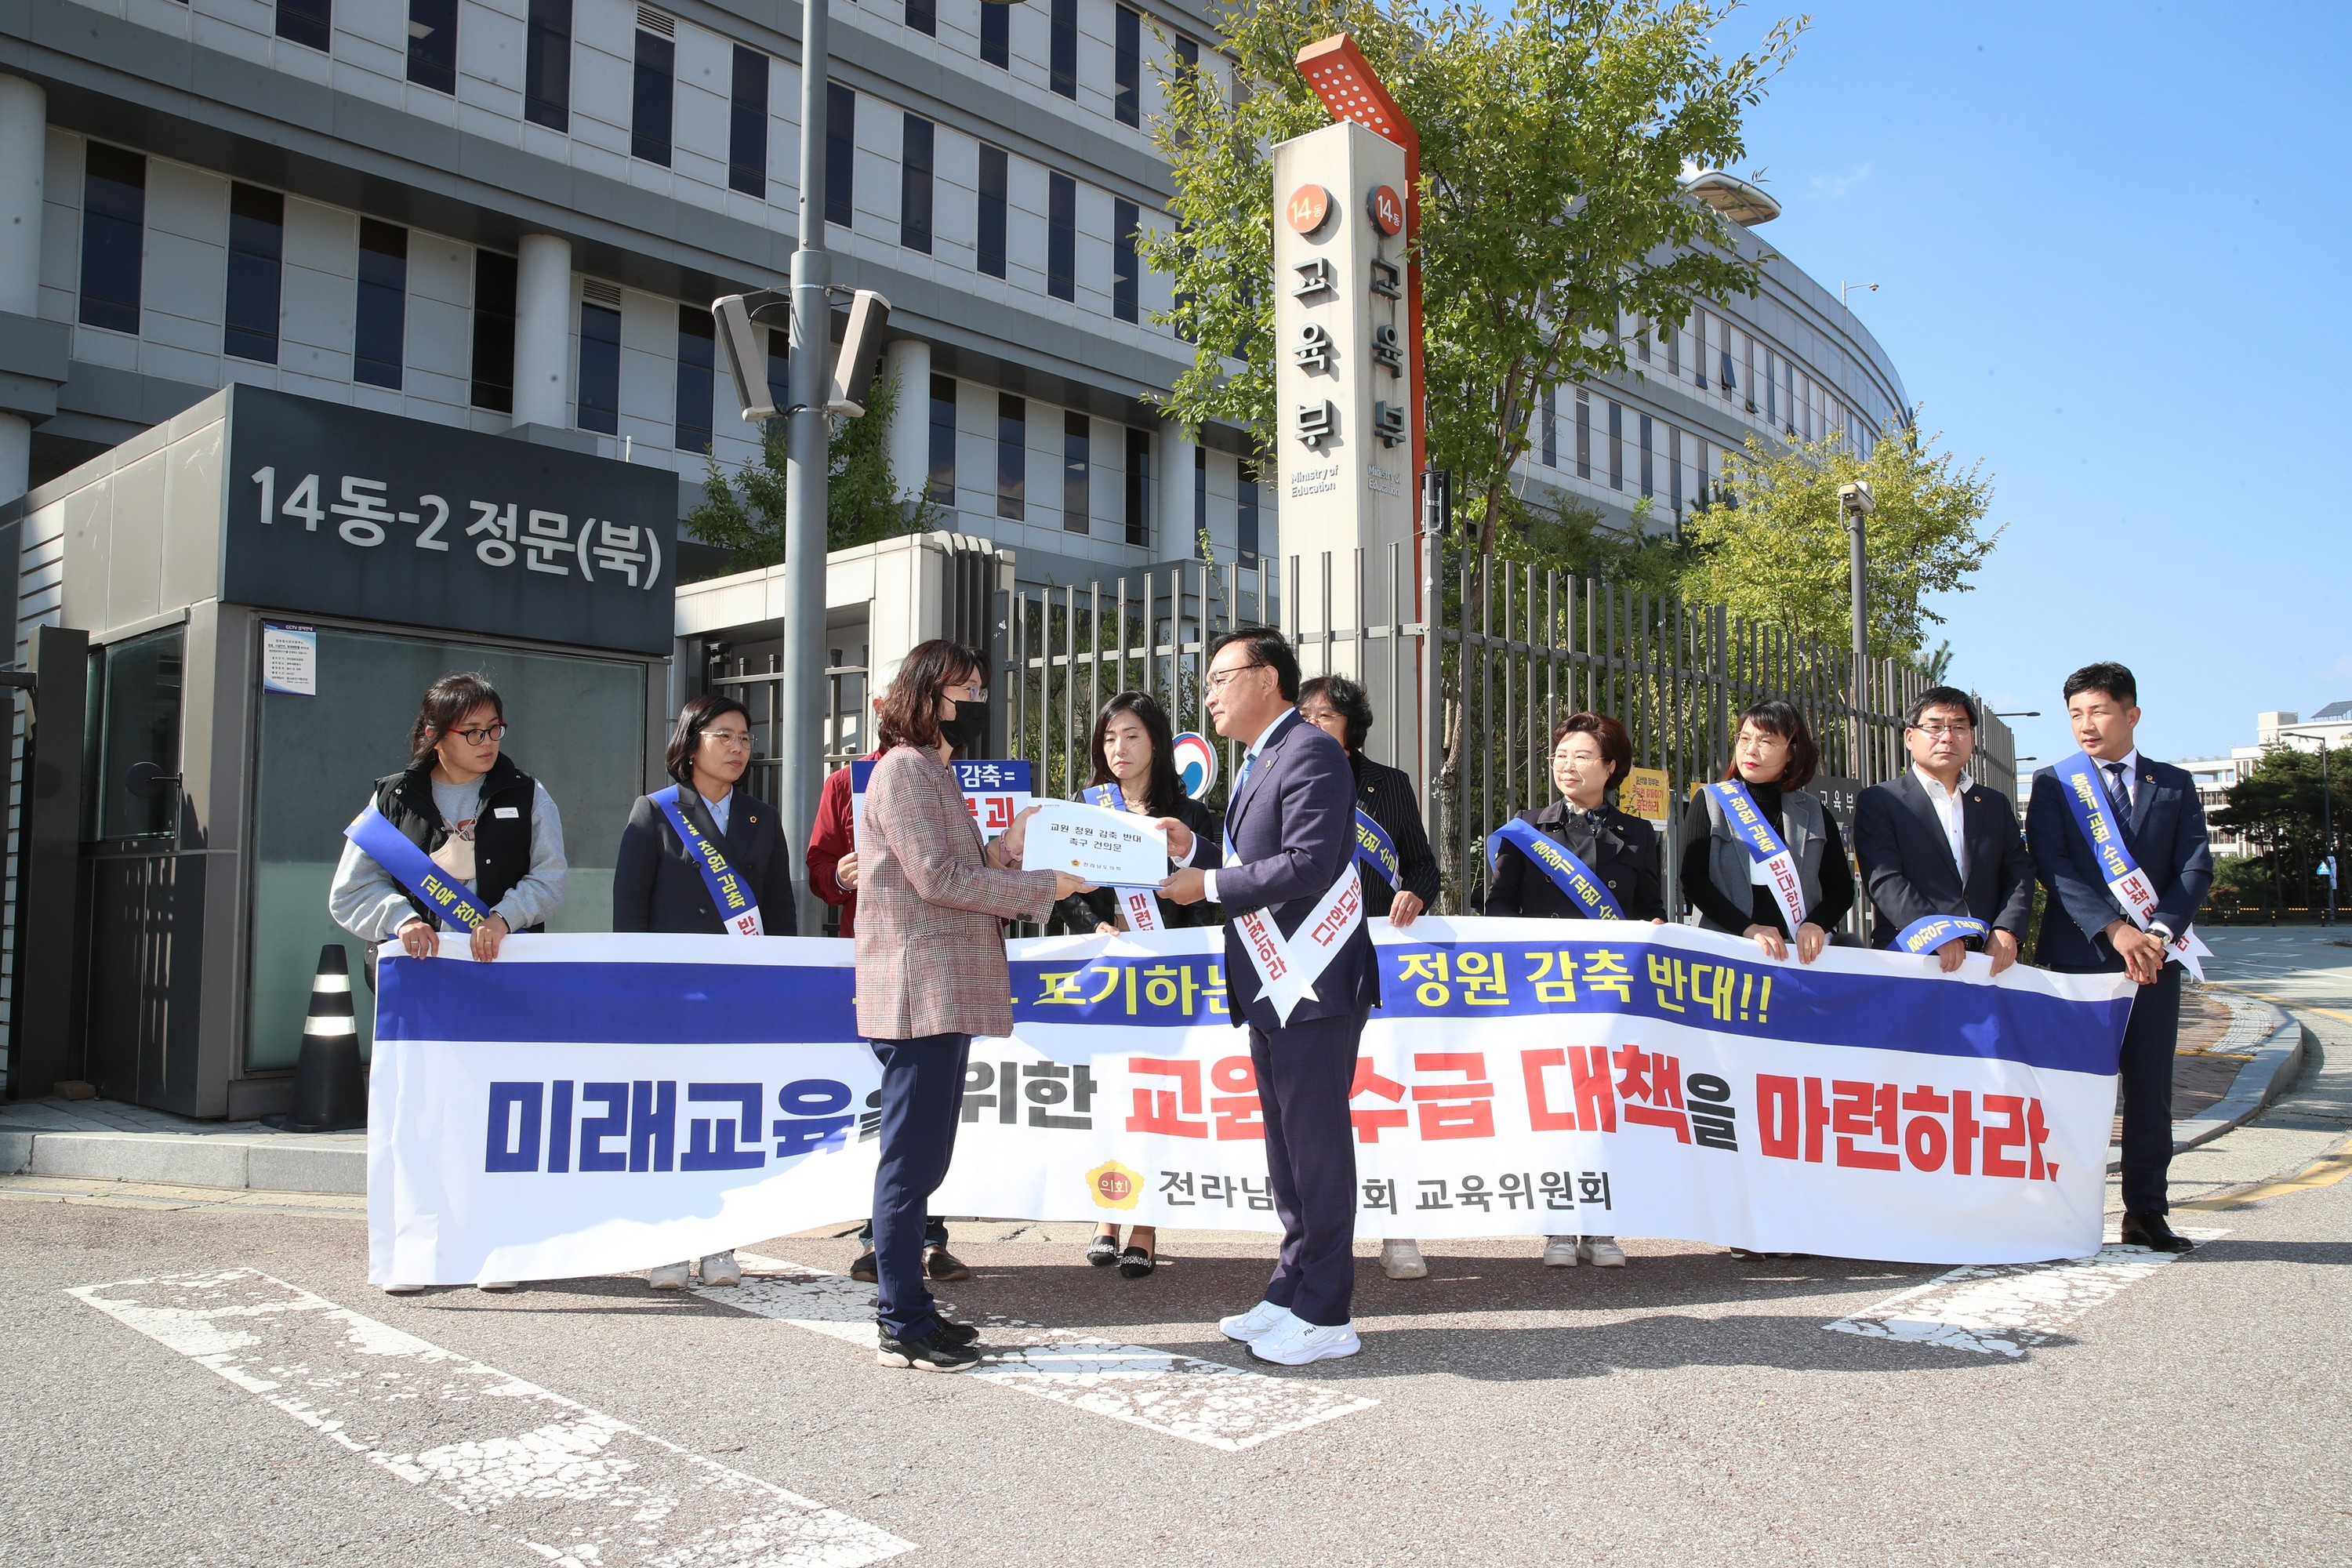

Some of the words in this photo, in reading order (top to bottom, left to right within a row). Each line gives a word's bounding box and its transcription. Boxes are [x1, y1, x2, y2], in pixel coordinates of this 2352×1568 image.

[1290, 196, 1323, 224] 14동
[1377, 194, 1400, 227] 14동
[1291, 256, 1334, 448] 교육부
[1371, 258, 1406, 448] 교육부
[1291, 468, 1328, 484] Ministry
[1330, 465, 1338, 477] of
[1291, 481, 1336, 498] Education
[1368, 464, 1394, 484] Ministry
[1395, 474, 1402, 484] of
[1368, 478, 1400, 497] Education
[251, 466, 450, 552] 14동-2
[466, 499, 662, 590] 정문(북)
[1636, 799, 1659, 812] 중단하라
[1051, 823, 1069, 833] 교원
[1075, 826, 1094, 837] 정원
[1099, 829, 1117, 840] 감축
[1123, 833, 1142, 843] 반대
[1729, 796, 1758, 825] 정원
[1748, 824, 1777, 853] 감축
[2071, 773, 2100, 811] 중장기
[2086, 815, 2111, 844] 교원
[2103, 844, 2129, 877] 수급
[1069, 837, 1088, 847] 촉구
[1094, 840, 1122, 852] 건의문
[1380, 848, 1396, 873] 수급
[420, 874, 457, 906] 교육
[1530, 840, 1575, 875] 중장기
[1569, 873, 1602, 907] 교원
[717, 873, 746, 909] 감축
[1769, 858, 1803, 924] 반대한다
[2120, 876, 2151, 906] 대책
[1907, 920, 1951, 953] 중장기
[1398, 951, 1508, 1007] 정원
[1526, 949, 1635, 1004] 감축
[1647, 953, 1772, 1023] 반대!!
[961, 1061, 1098, 1130] 위한
[1348, 1052, 1495, 1144] 수급
[1100, 1179, 1128, 1193] 의회
[1415, 1171, 1612, 1213] 교육위원회
